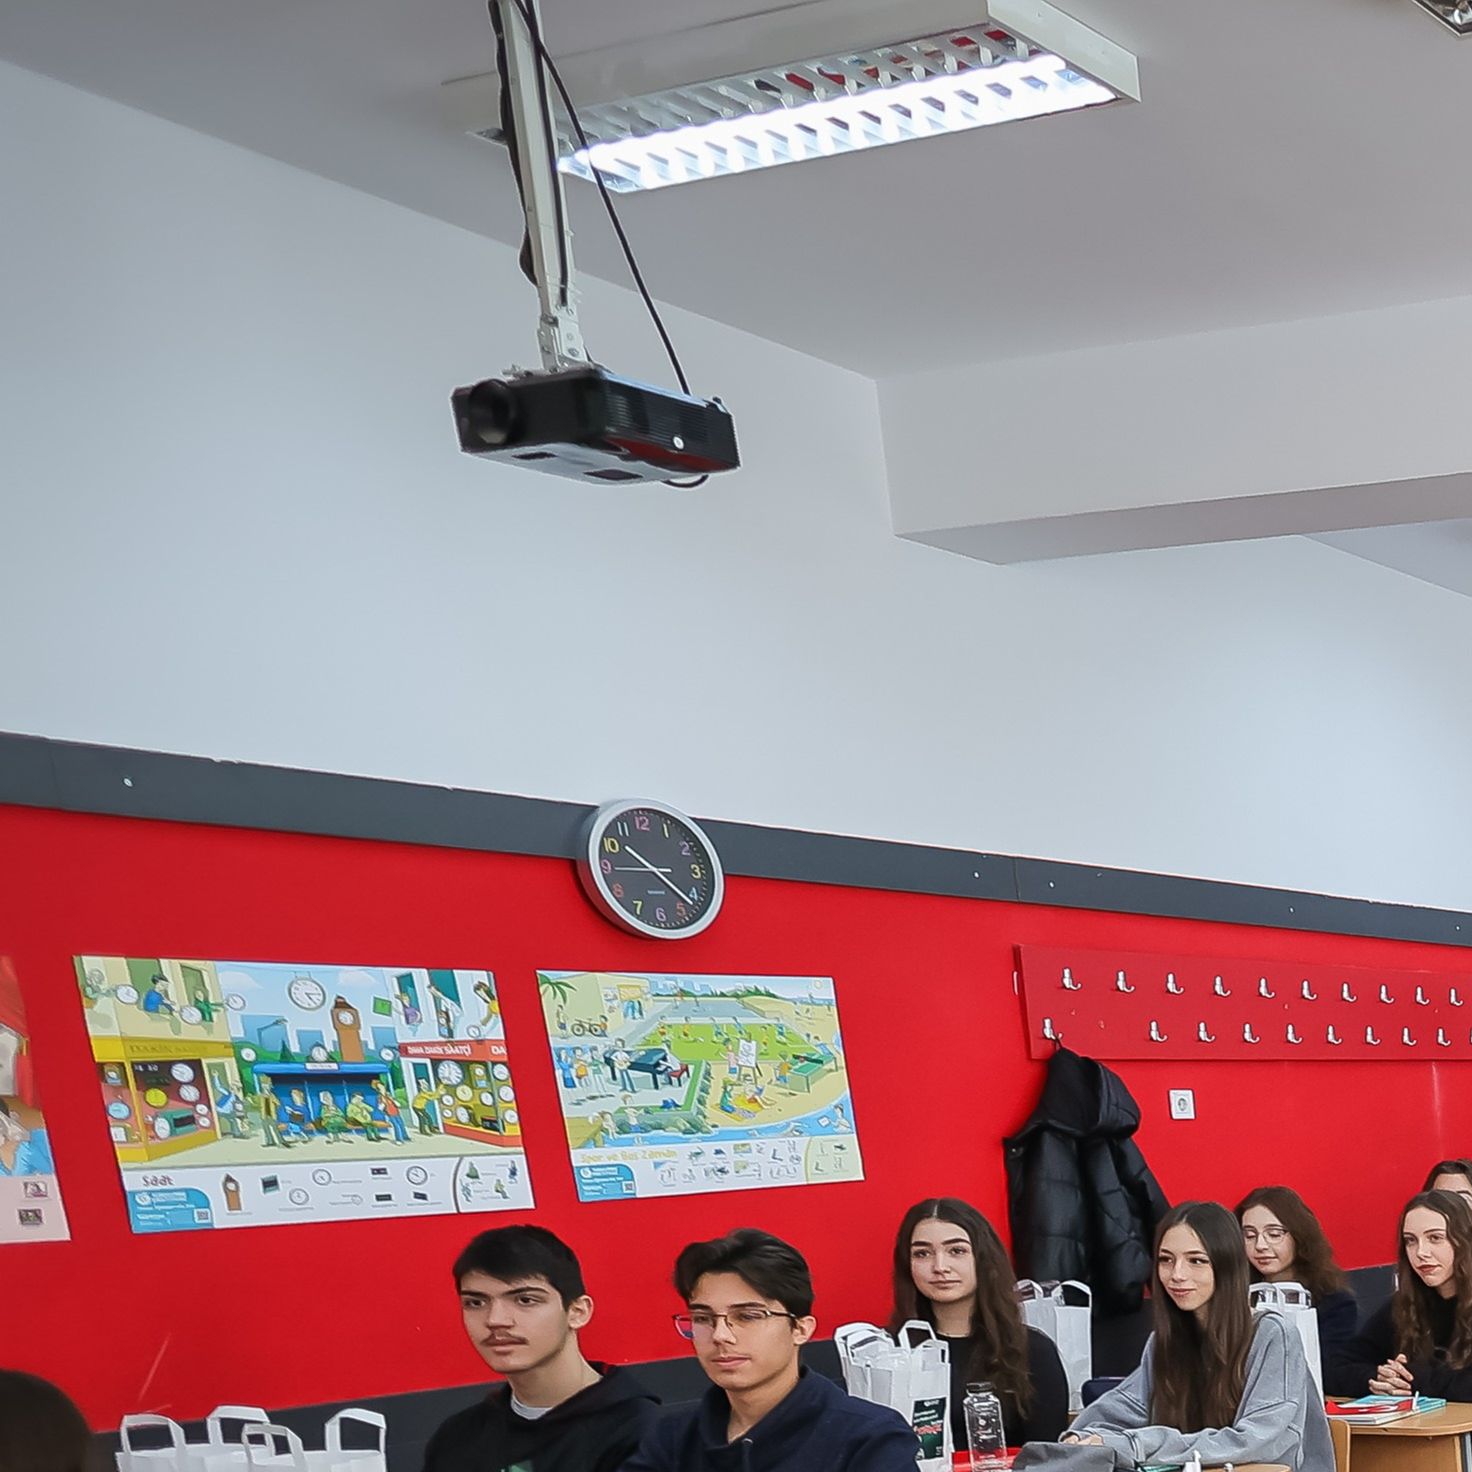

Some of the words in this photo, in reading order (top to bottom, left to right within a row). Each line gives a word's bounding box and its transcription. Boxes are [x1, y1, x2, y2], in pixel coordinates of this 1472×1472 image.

[617, 821, 629, 837] 11
[634, 815, 650, 831] 12
[662, 823, 669, 839] 1
[603, 837, 620, 853] 10
[680, 841, 691, 856] 2
[601, 859, 612, 874] 9
[690, 864, 702, 879] 3
[612, 883, 624, 897] 8
[689, 886, 698, 900] 4
[632, 900, 642, 915] 7
[655, 907, 667, 922] 6
[676, 902, 686, 917] 5
